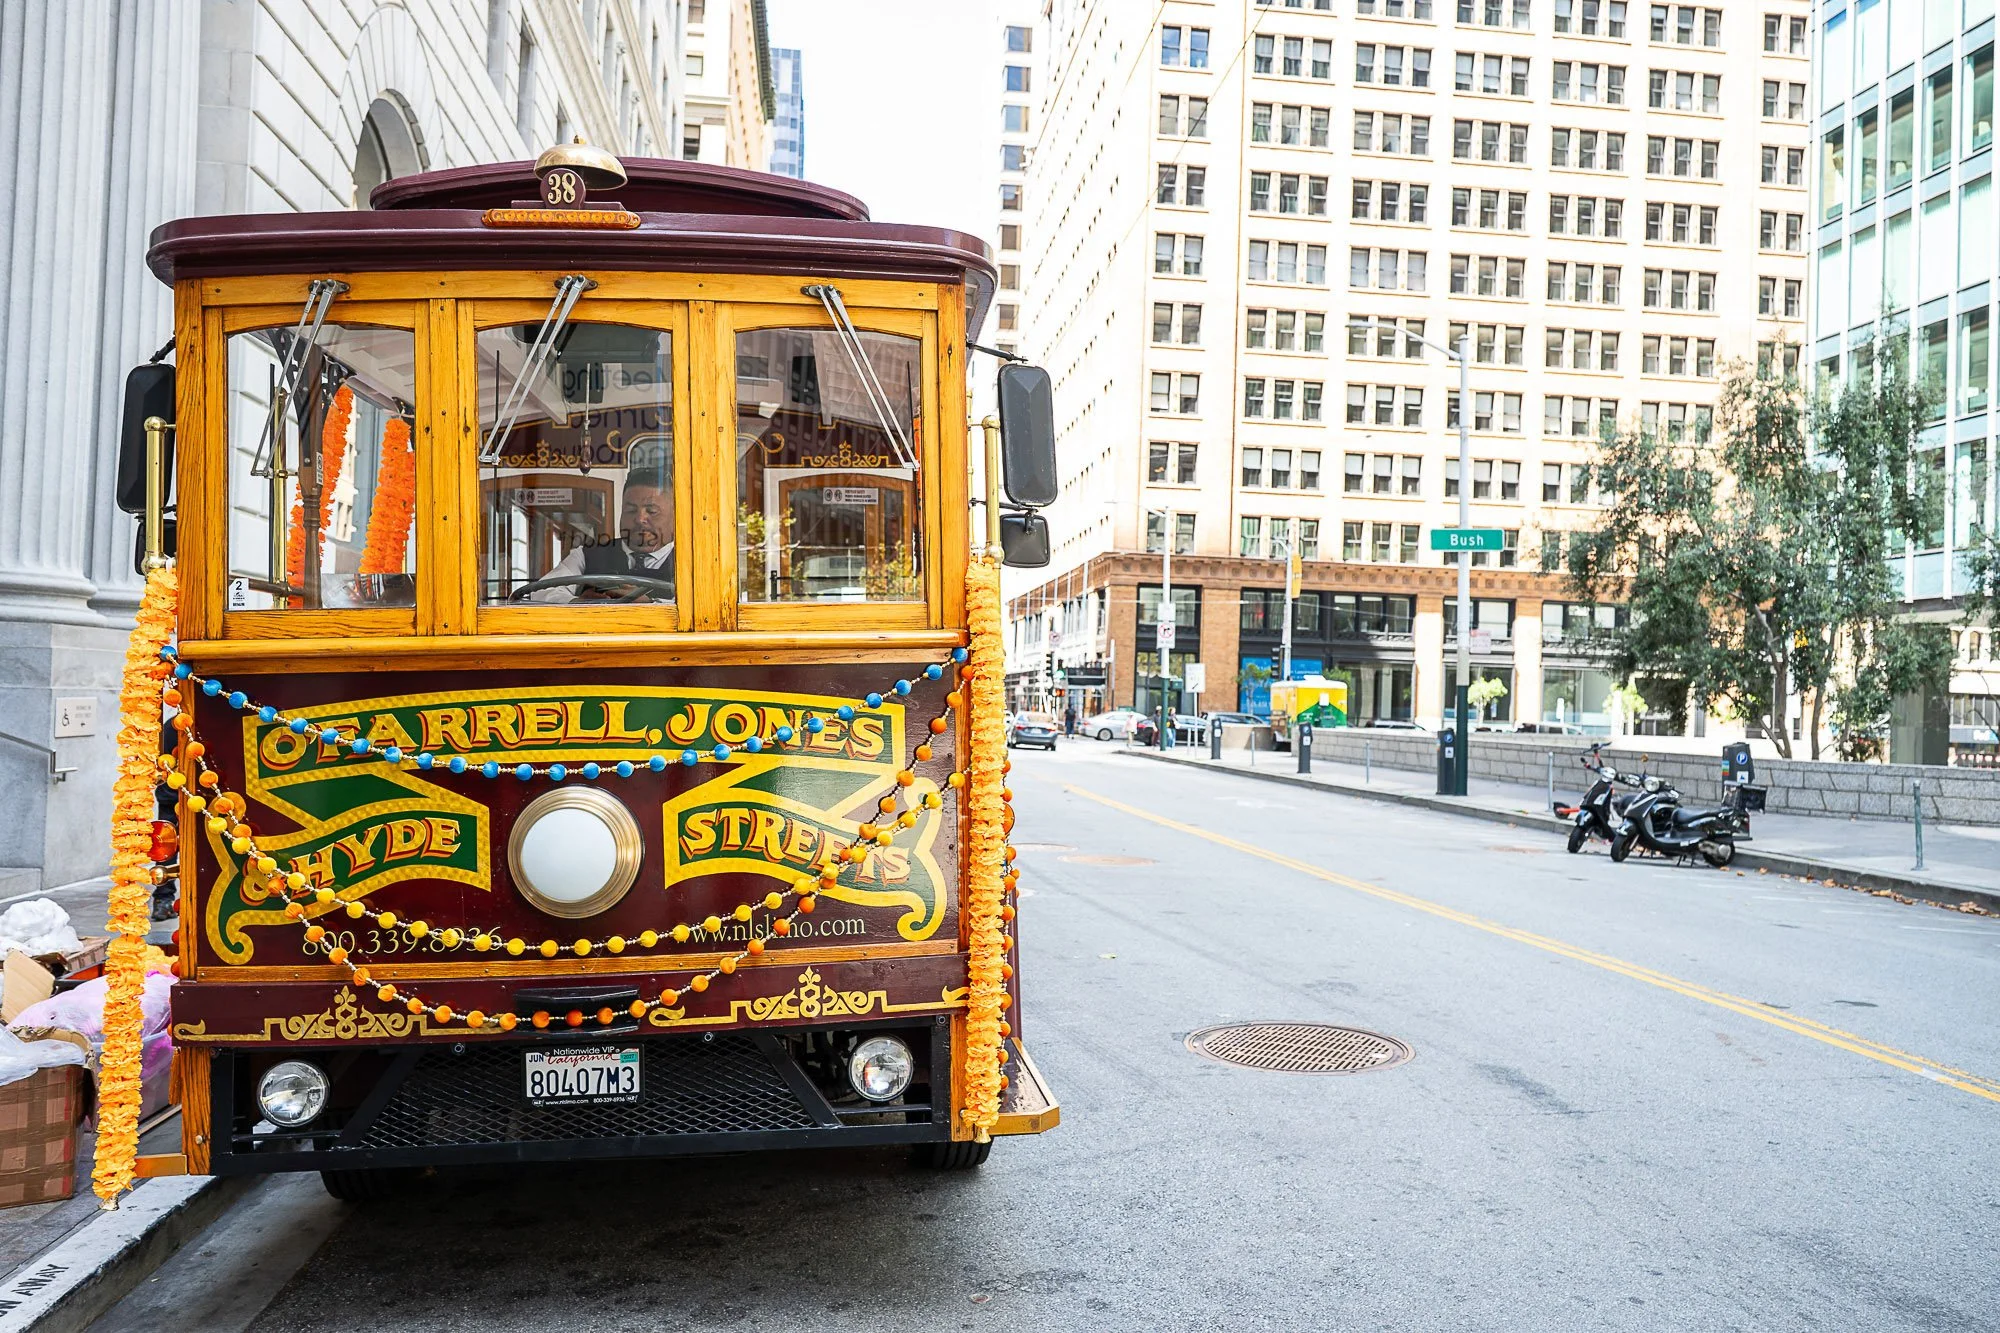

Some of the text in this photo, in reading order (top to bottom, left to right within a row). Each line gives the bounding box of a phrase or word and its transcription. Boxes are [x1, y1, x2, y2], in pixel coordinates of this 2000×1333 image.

[547, 173, 576, 205] 38
[1450, 534, 1484, 546] Bush
[235, 581, 243, 590] 2
[665, 703, 885, 760] JONES
[288, 817, 461, 900] HYDE
[529, 1054, 544, 1062] JUN
[547, 1054, 621, 1067] California
[553, 1048, 600, 1056] Nationwide
[530, 1066, 635, 1097] 80407M3
[11, 1264, 69, 1296] AWAY
